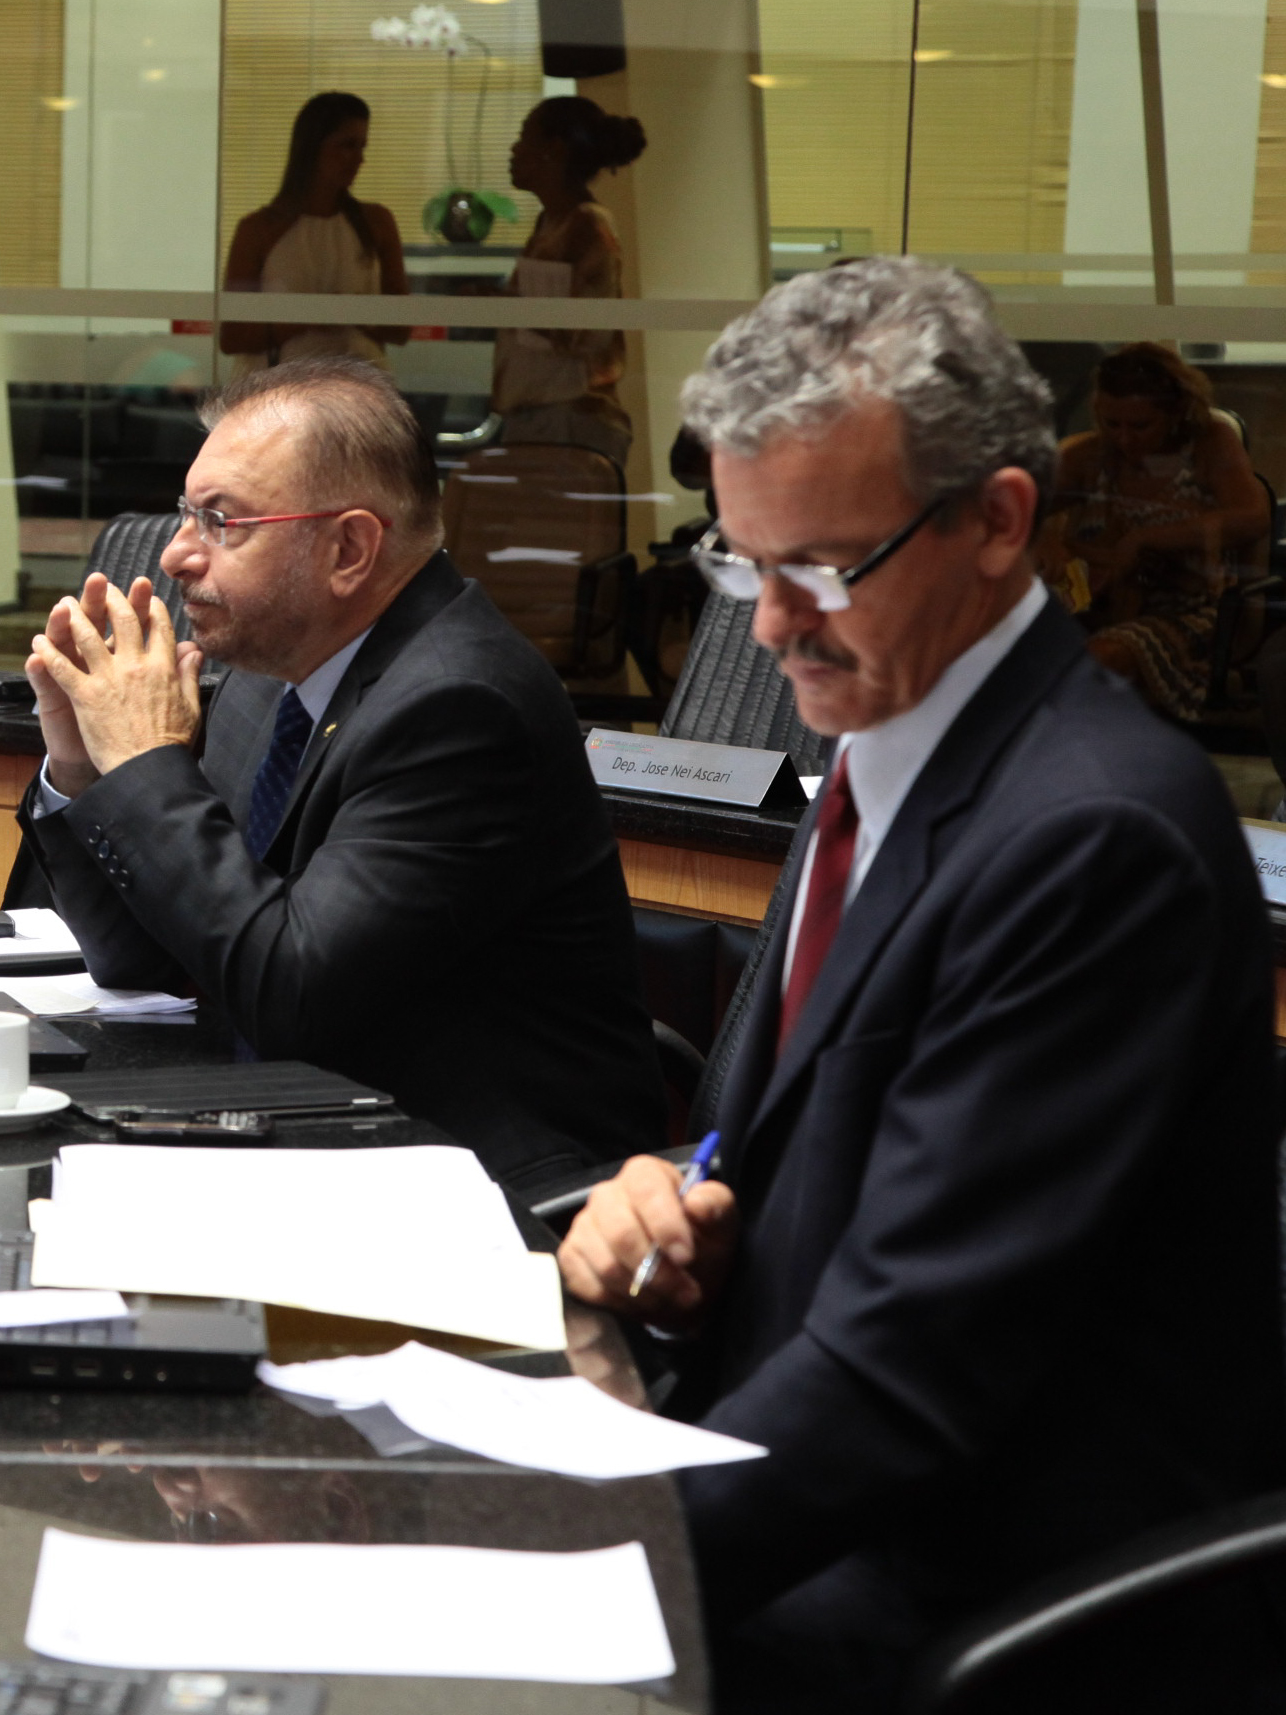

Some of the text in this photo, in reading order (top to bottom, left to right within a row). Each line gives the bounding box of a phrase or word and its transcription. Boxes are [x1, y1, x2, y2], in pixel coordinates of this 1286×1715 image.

[612, 756, 732, 783] Dep. Jose Nei Ascari
[1255, 857, 1286, 878] Teixe
